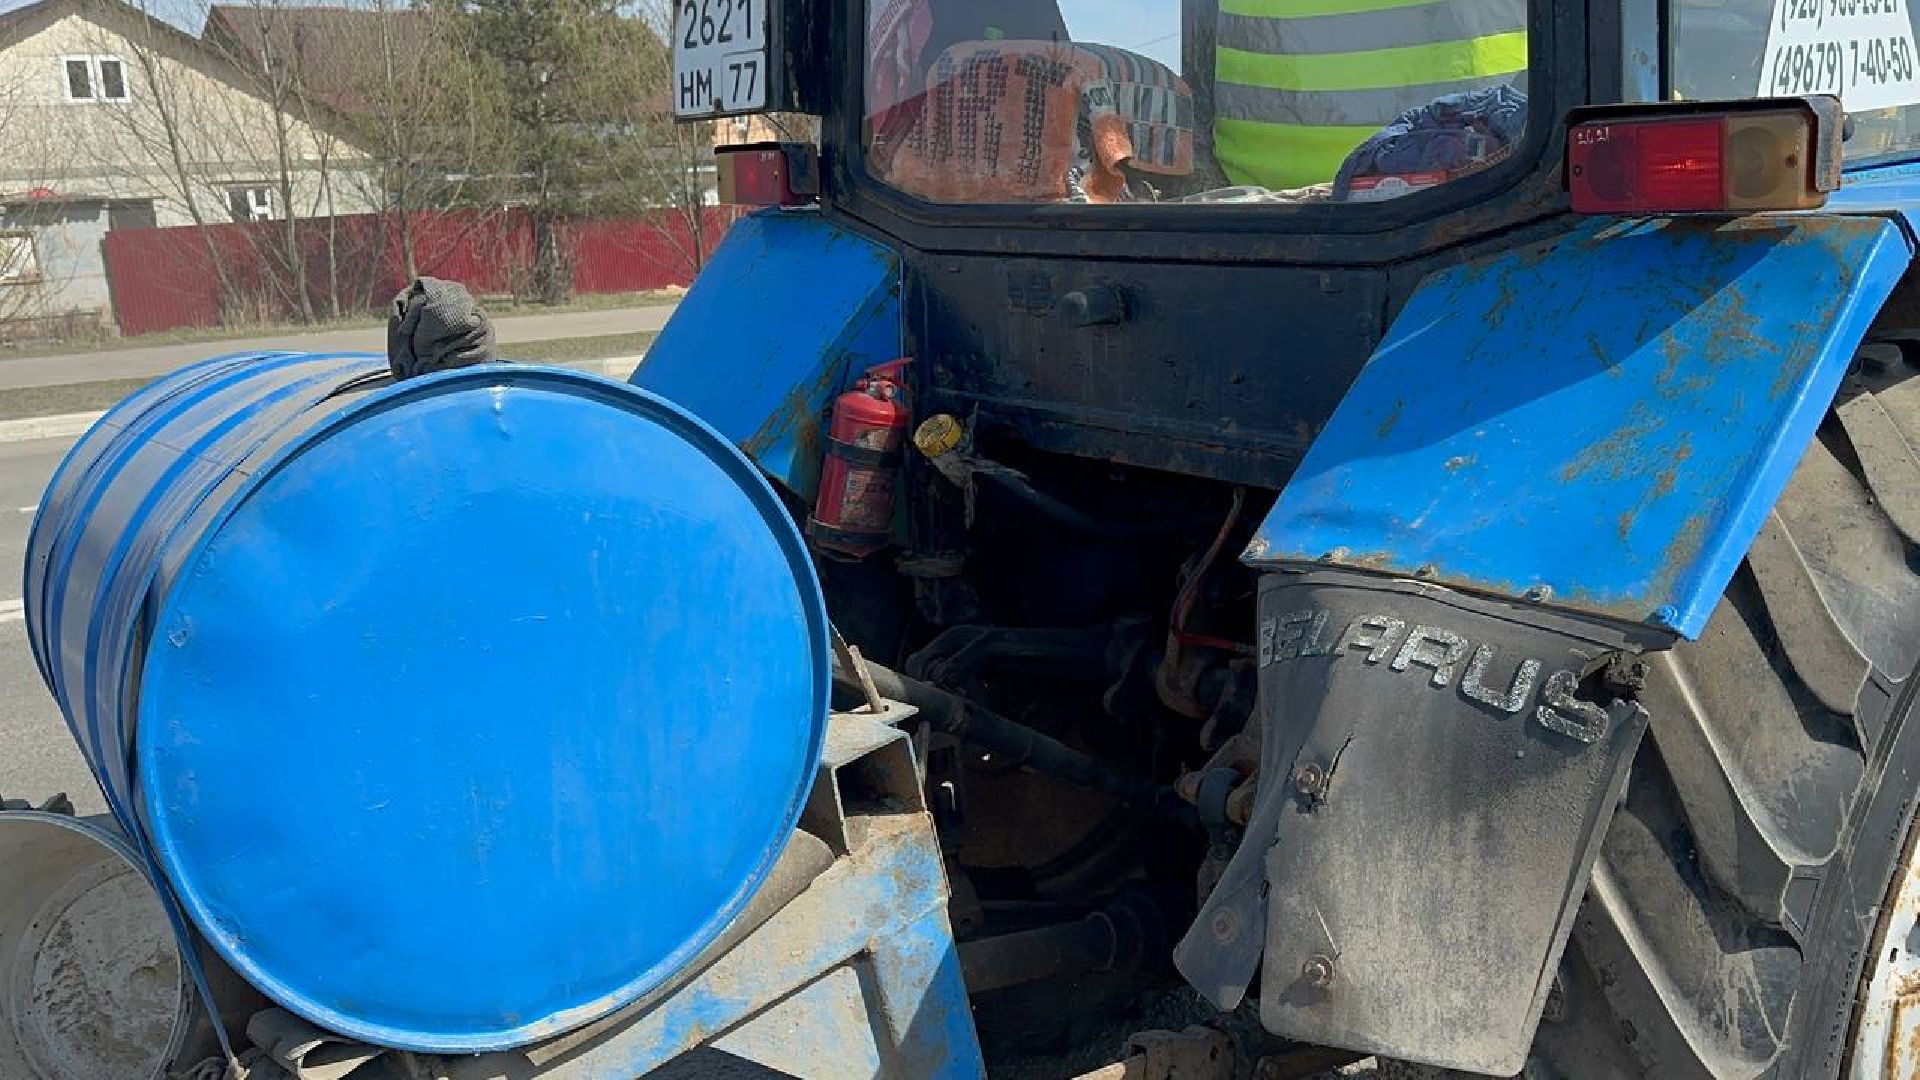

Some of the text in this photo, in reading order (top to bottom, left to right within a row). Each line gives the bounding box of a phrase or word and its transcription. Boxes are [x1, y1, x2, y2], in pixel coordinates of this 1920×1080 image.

[684, 0, 752, 49] 2621
[729, 60, 757, 103] 77
[1771, 36, 1913, 98] (49679) 7-40-50
